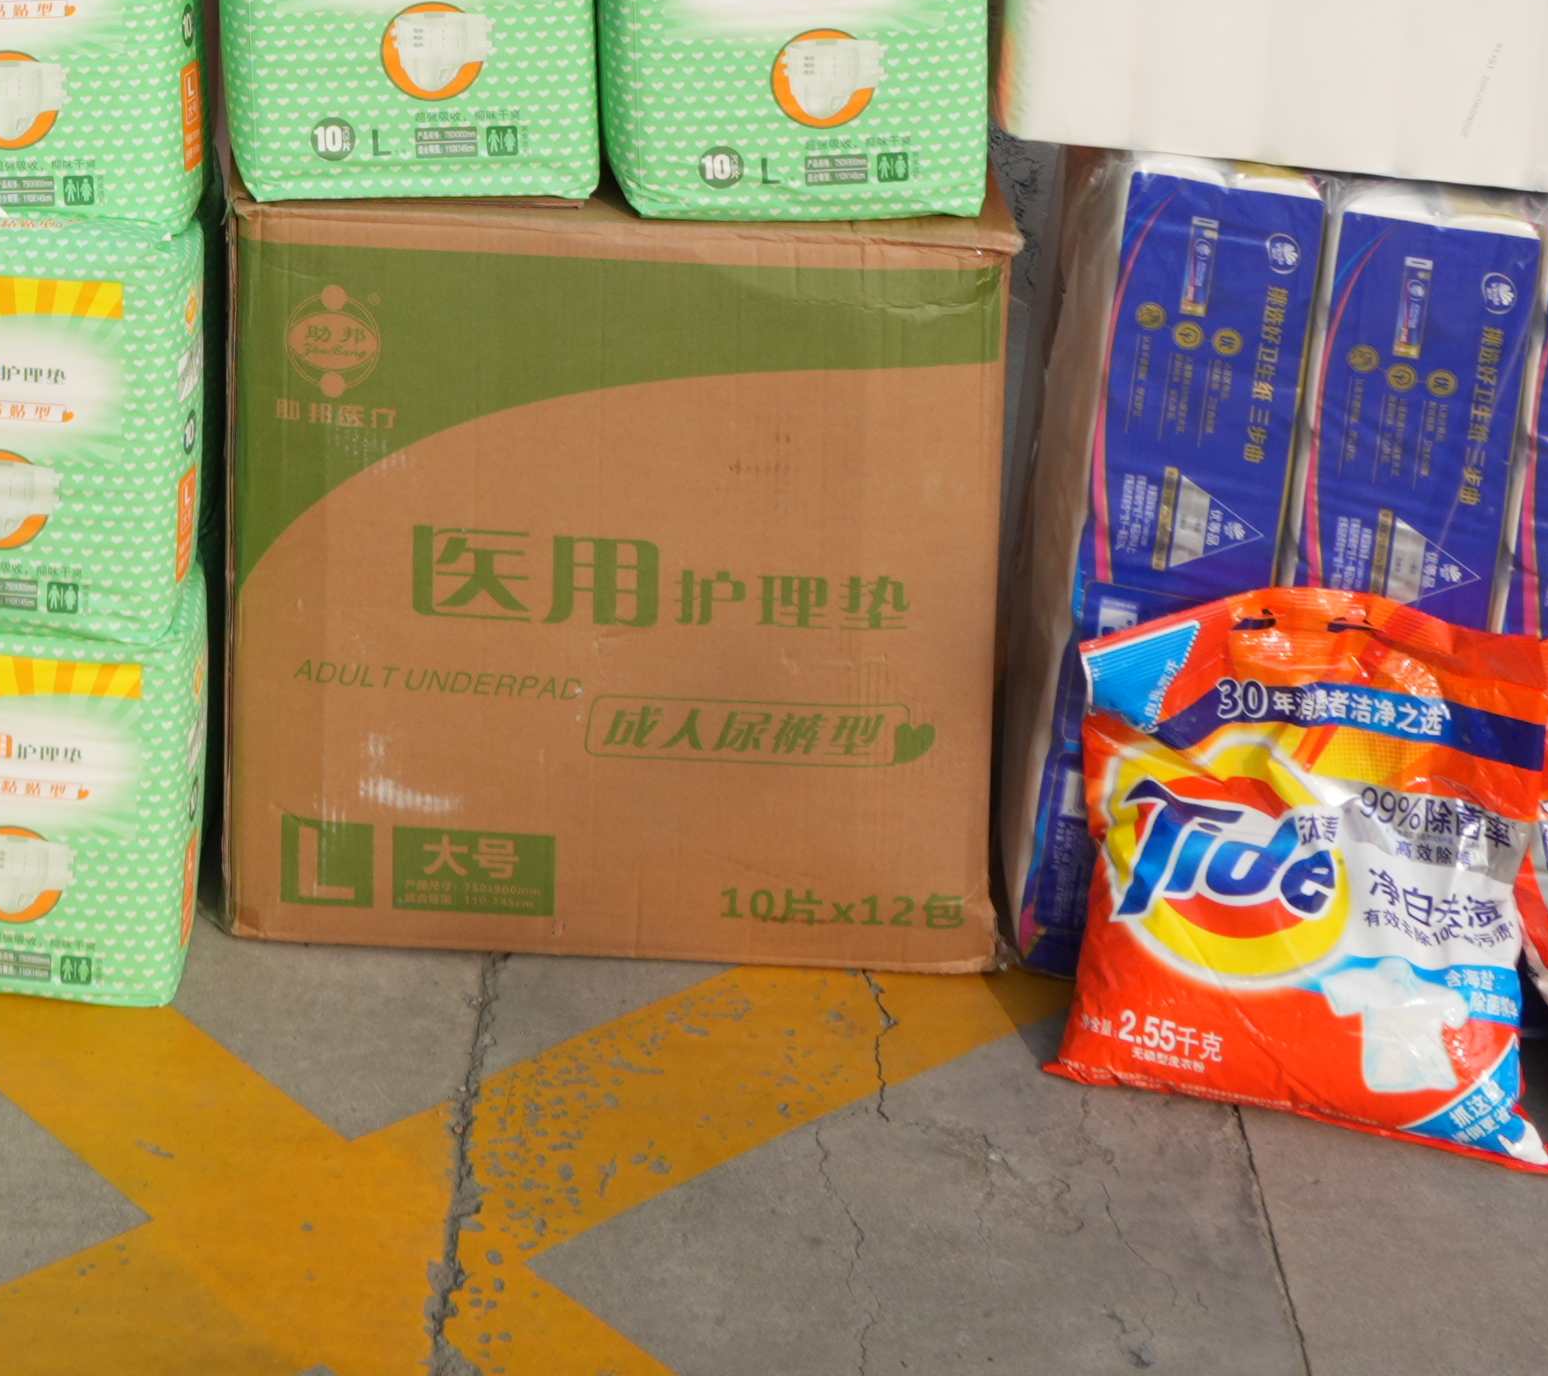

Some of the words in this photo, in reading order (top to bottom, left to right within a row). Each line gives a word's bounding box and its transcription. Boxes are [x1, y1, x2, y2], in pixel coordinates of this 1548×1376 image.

[372, 129, 391, 156] L
[761, 158, 779, 184] L
[308, 325, 366, 343] 助邦
[274, 398, 397, 429] 助邦医疗
[410, 524, 911, 630] 医用护理垫
[295, 659, 398, 691] ADULT
[404, 665, 583, 702] UNDERPAD
[602, 704, 882, 758] 成人尿裤型
[299, 825, 355, 899] L
[423, 833, 519, 879] 大号
[1110, 778, 1338, 922] Tide
[720, 886, 966, 930] 10片x12包
[1118, 1010, 1223, 1063] 2.55千克
